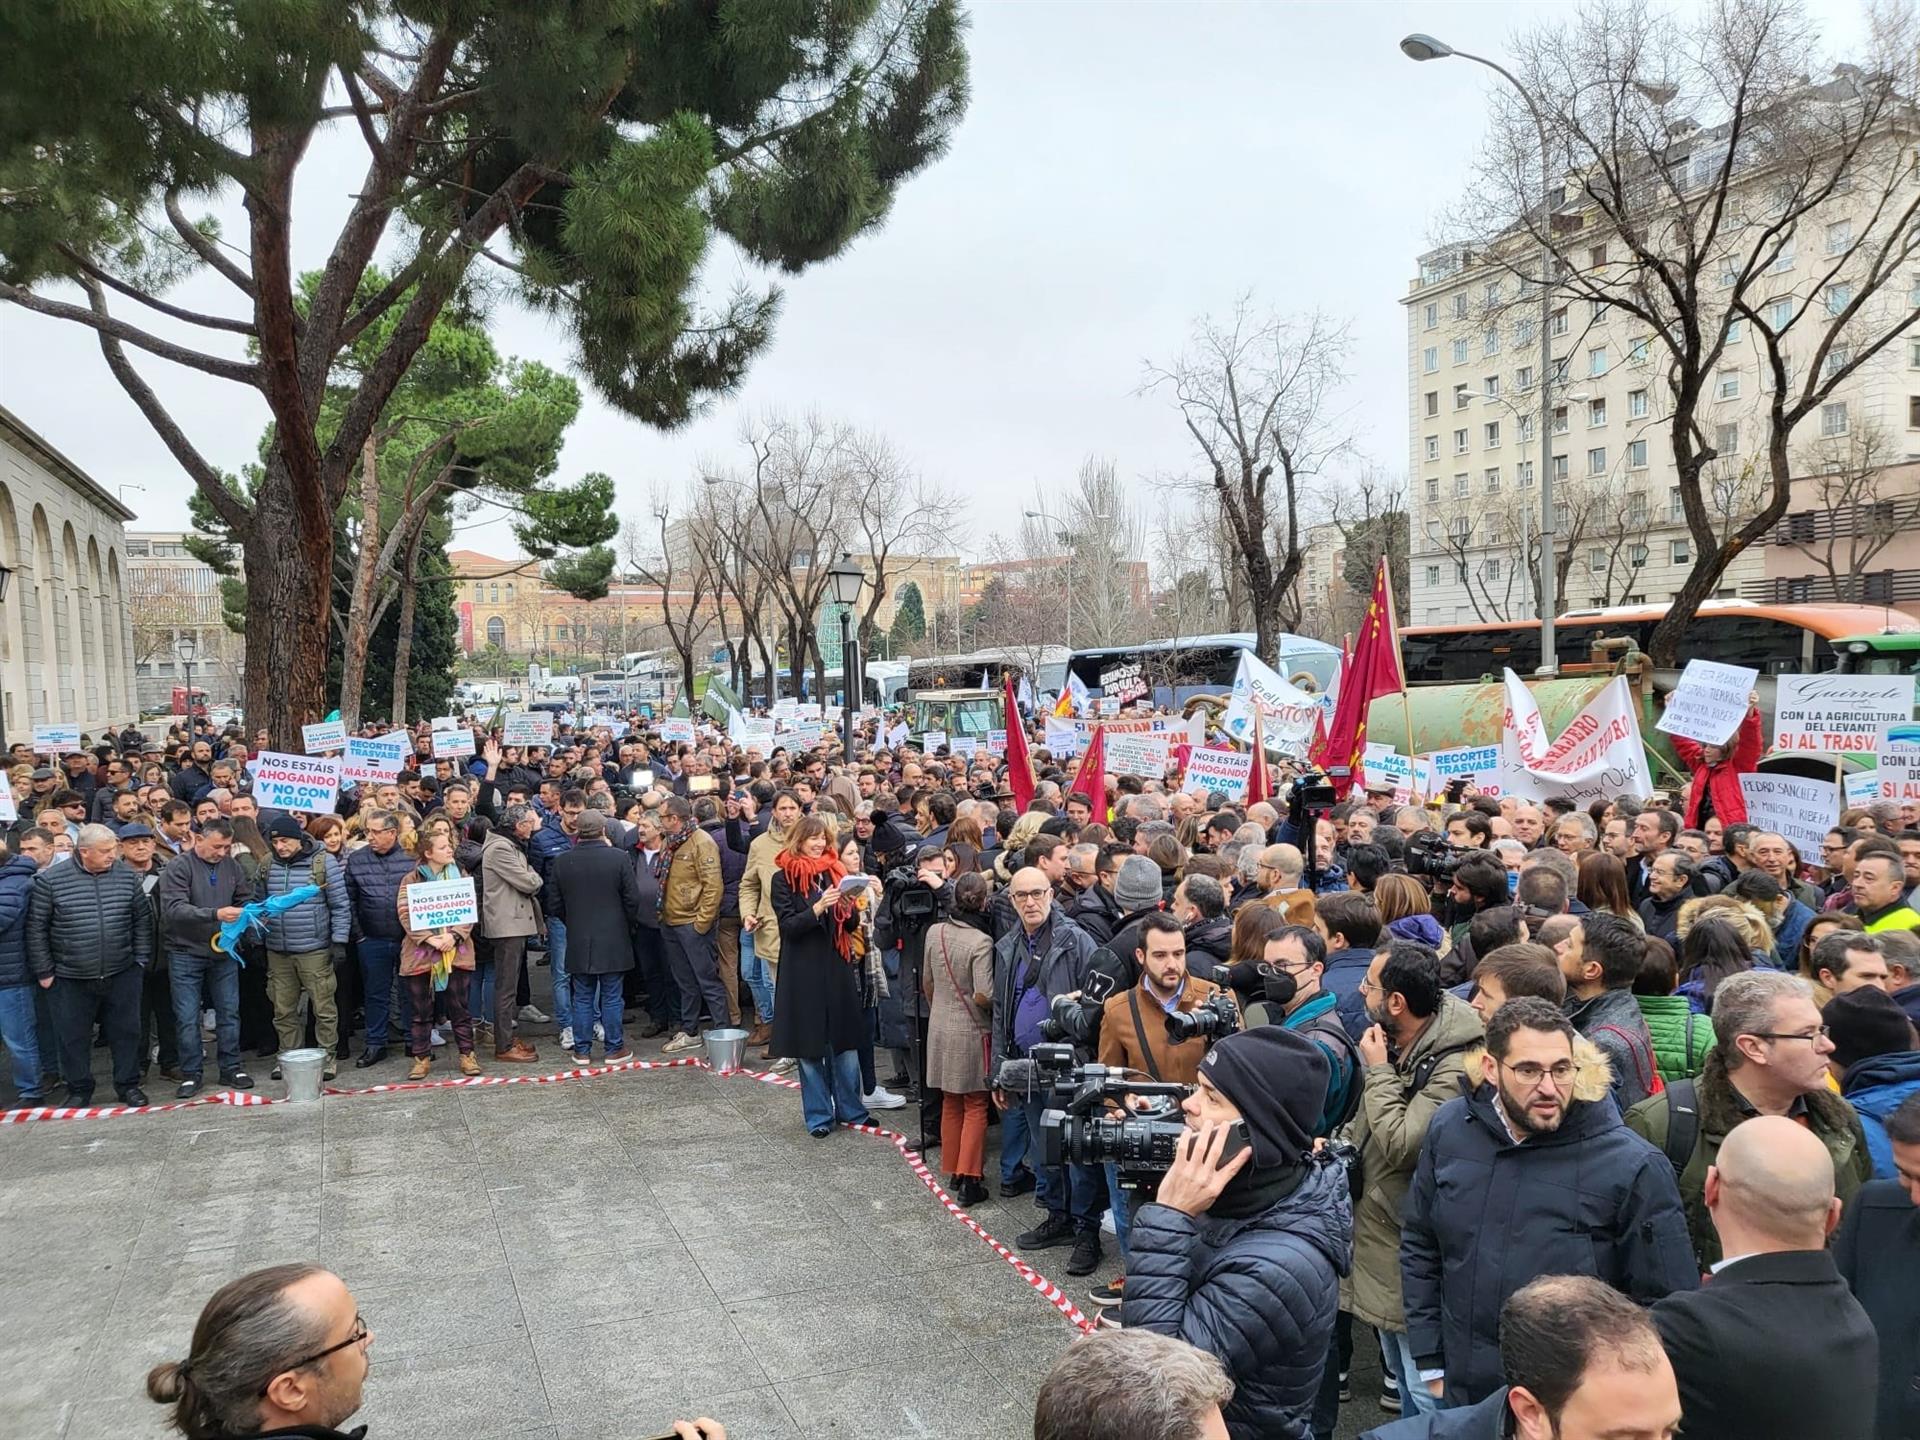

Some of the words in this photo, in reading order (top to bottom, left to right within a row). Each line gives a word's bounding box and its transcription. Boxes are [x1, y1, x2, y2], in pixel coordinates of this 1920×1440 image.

[1780, 711, 1804, 720] CON
[1808, 711, 1822, 720] LA
[1826, 712, 1906, 722] AGRICULTURA
[1074, 722, 1085, 732] SI
[1152, 720, 1166, 731] EL
[1805, 722, 1826, 732] DEL
[1599, 715, 1631, 756] PEDRO
[1779, 733, 1793, 749] SI
[1798, 734, 1817, 750] AL
[1823, 734, 1877, 751] TRASV
[350, 740, 401, 752] RECORTES
[350, 748, 400, 760] TRASVASE
[1194, 752, 1216, 762] NOS
[1217, 756, 1249, 767] ESTÁIS
[1435, 748, 1497, 765] RECORTES
[1882, 755, 1906, 767] CON
[262, 757, 289, 768] NOS
[291, 760, 335, 774] ESTÁIS
[1384, 756, 1406, 767] MÁS
[1436, 760, 1497, 775] TRASVASE
[1189, 762, 1248, 778] AHOGANDO
[257, 769, 336, 787] AHOGANDO
[1191, 773, 1200, 782] Y
[1200, 775, 1217, 785] NO
[1220, 778, 1243, 789] CON
[261, 782, 271, 792] Y
[273, 784, 294, 795] NO
[297, 786, 330, 799] CON
[1743, 780, 1775, 793] PEDRO
[1828, 791, 1835, 804] Y
[1882, 781, 1897, 798] SI
[272, 795, 313, 808] AGUA
[412, 896, 434, 905] NOS
[436, 891, 471, 901] ESTÁIS
[411, 899, 474, 913] AHOGANDO
[426, 911, 444, 919] NO
[446, 907, 472, 917] CON
[428, 917, 461, 926] AGUA
